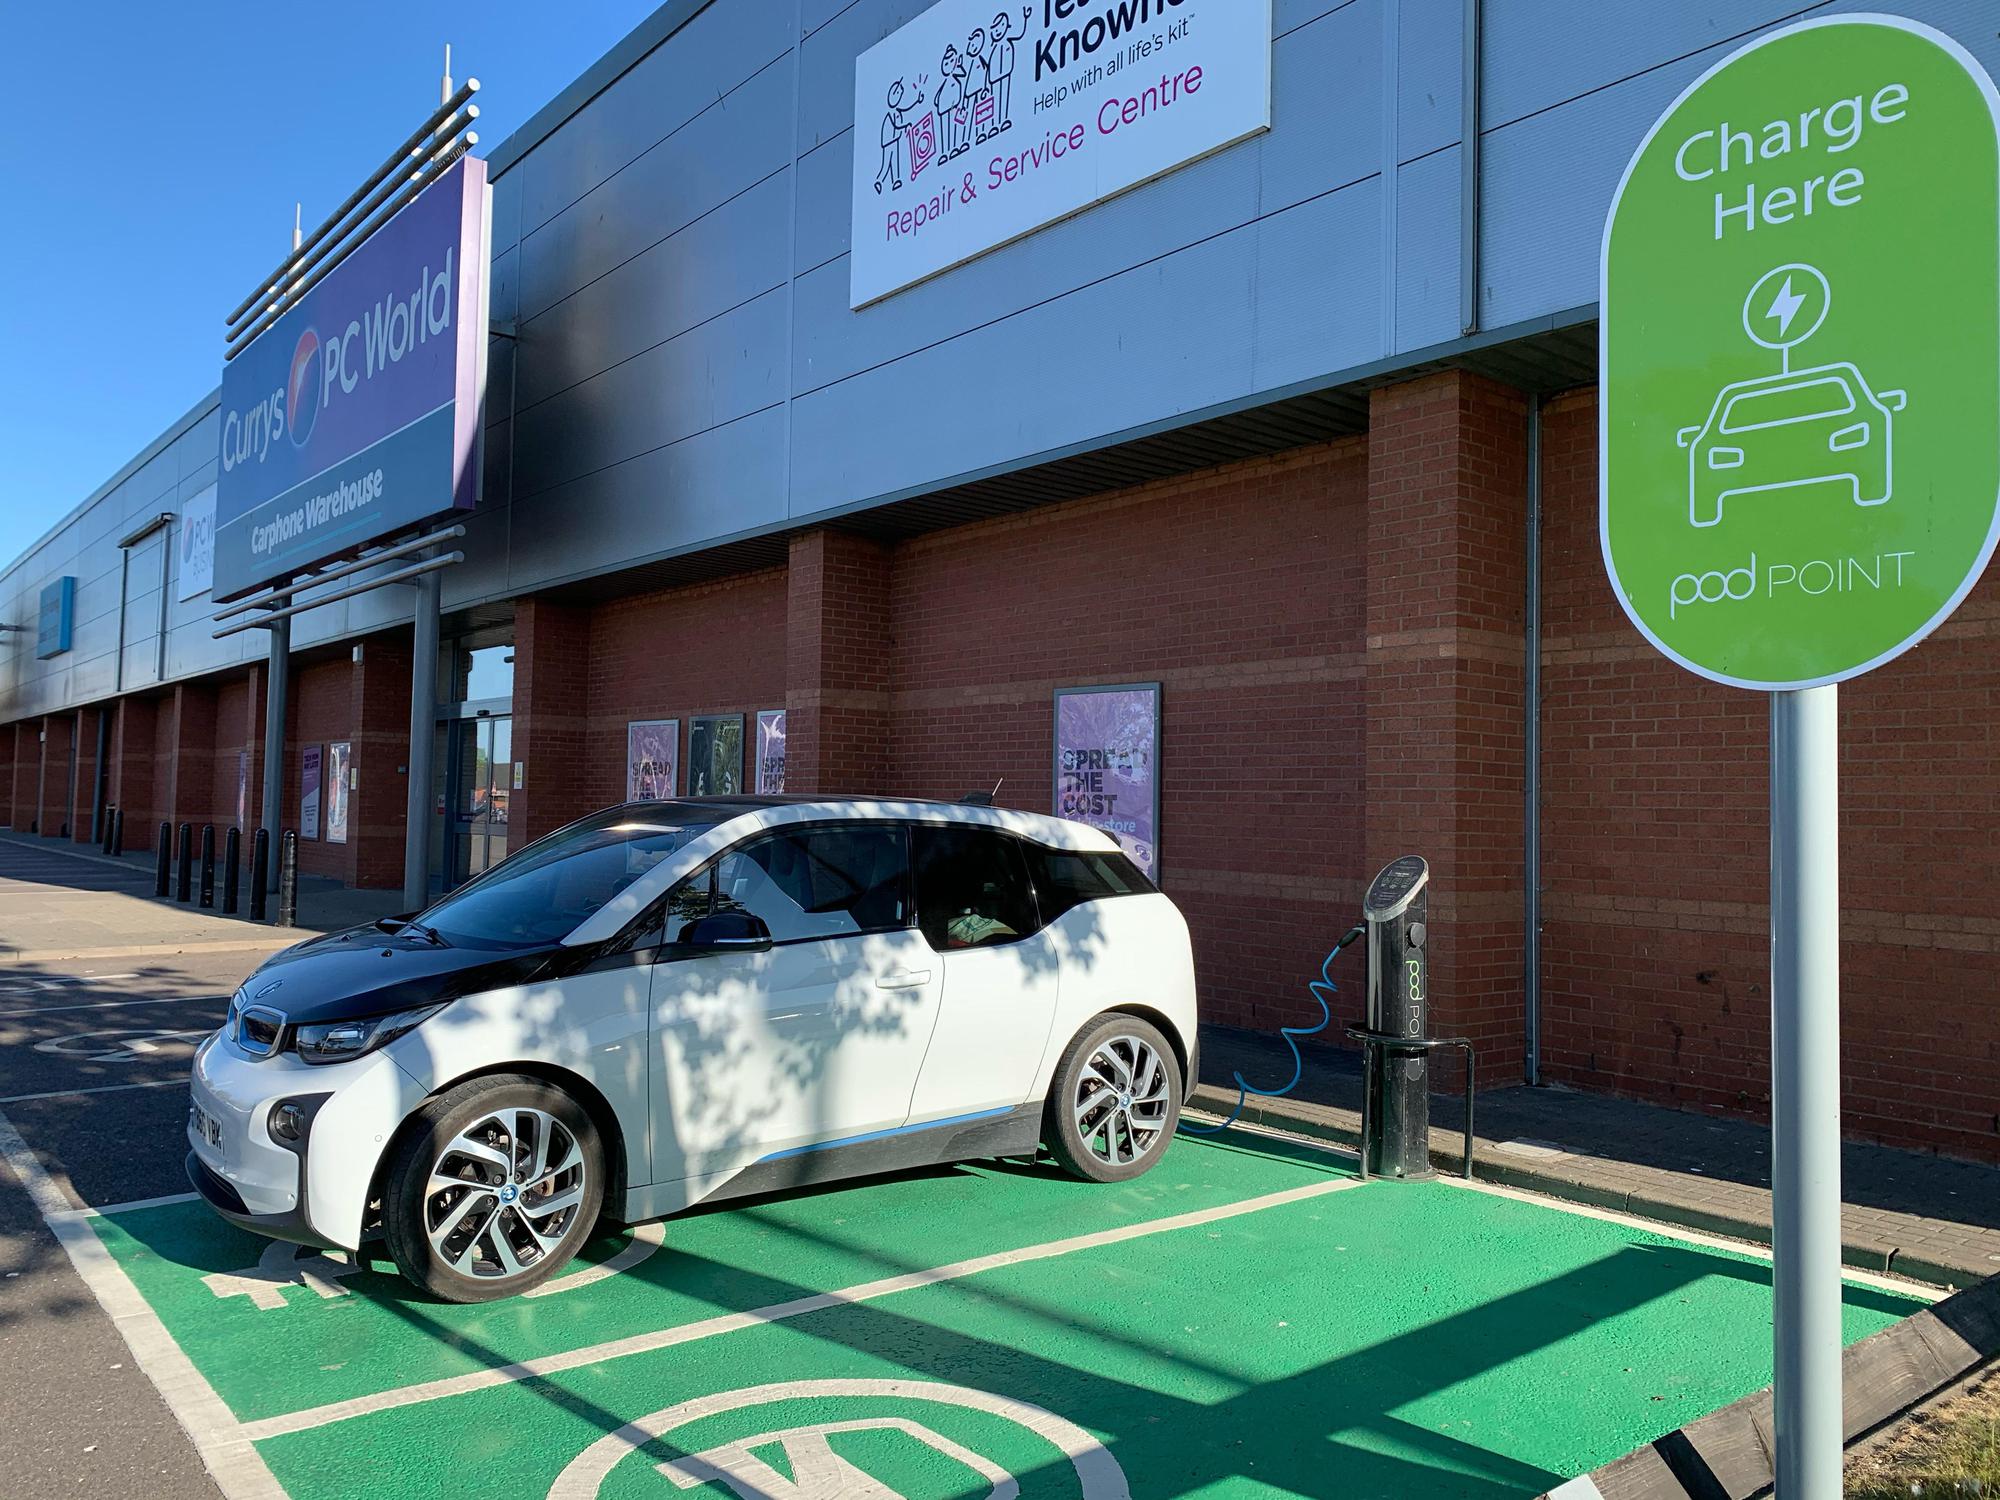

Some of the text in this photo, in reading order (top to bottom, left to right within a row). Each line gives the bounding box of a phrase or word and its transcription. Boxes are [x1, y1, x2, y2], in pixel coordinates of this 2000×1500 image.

[1033, 86, 1068, 115] Help
[1070, 64, 1103, 95] with
[1106, 50, 1124, 76] all
[1128, 33, 1163, 66] life's
[886, 65, 1203, 242] Repair & Service Centre
[1674, 83, 1909, 182] Charge
[1714, 167, 1865, 241] Here
[222, 246, 453, 472] Currys PC World
[251, 507, 304, 554] Carphone
[305, 468, 383, 530] Warehouse
[1670, 551, 1916, 621] pod POINT
[1063, 772, 1104, 793] THE
[1063, 794, 1118, 816] COST
[1405, 959, 1424, 1001] pod
